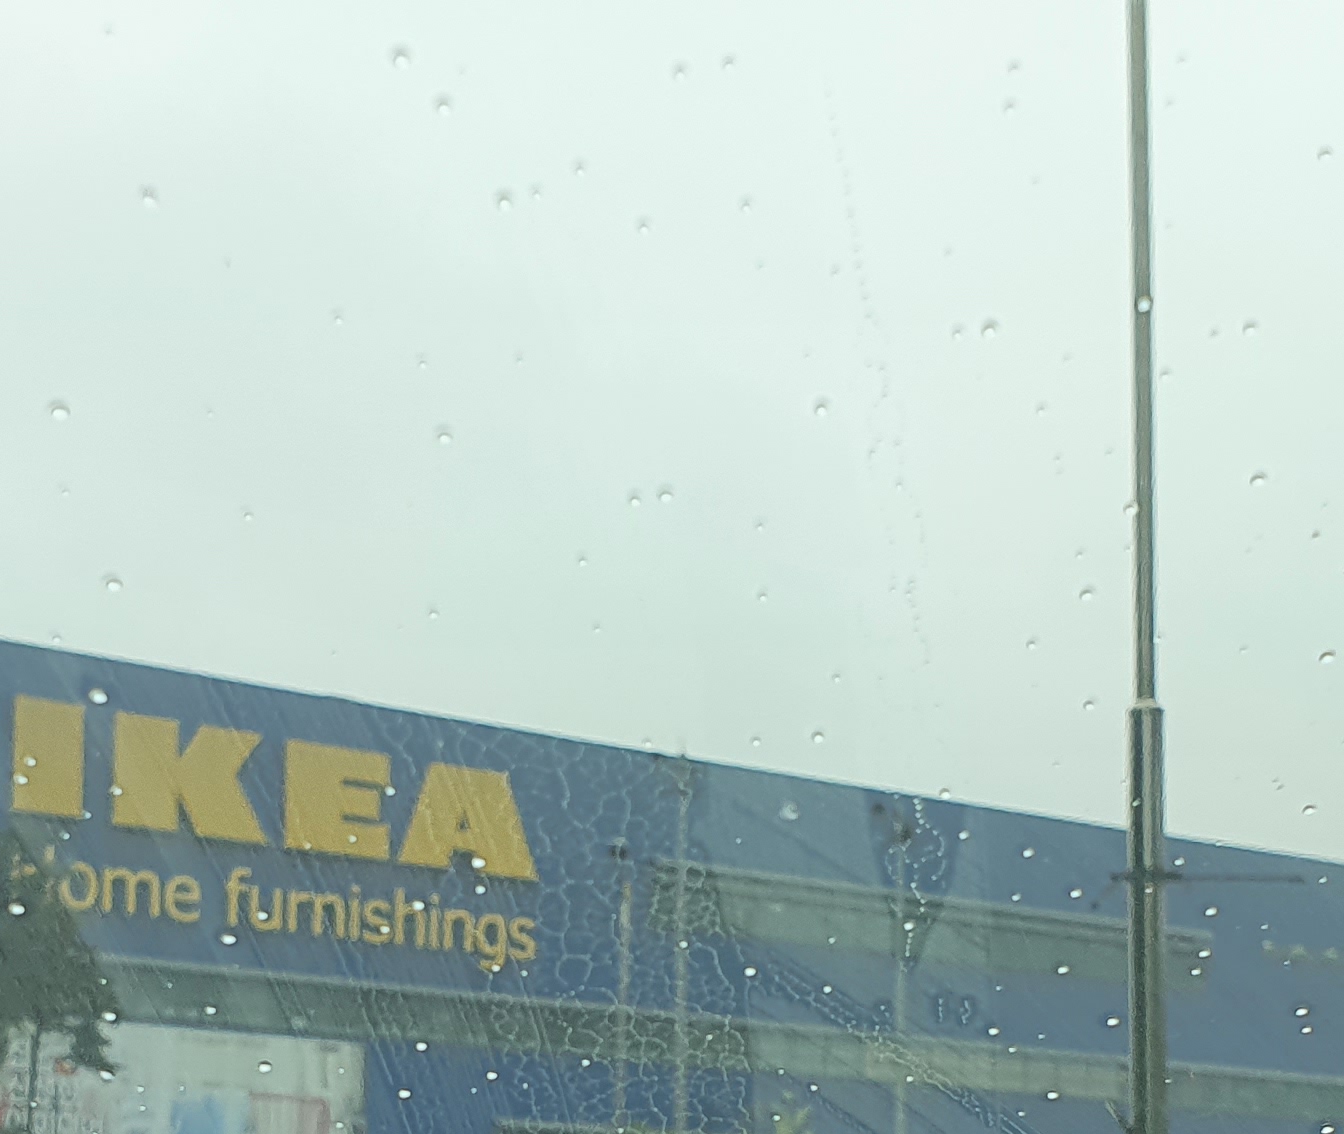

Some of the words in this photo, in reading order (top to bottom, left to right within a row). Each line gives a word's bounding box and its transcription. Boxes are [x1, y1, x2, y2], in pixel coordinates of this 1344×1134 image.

[12, 695, 538, 881] IKEA
[11, 844, 203, 924] ome
[224, 866, 538, 972] furnishings
